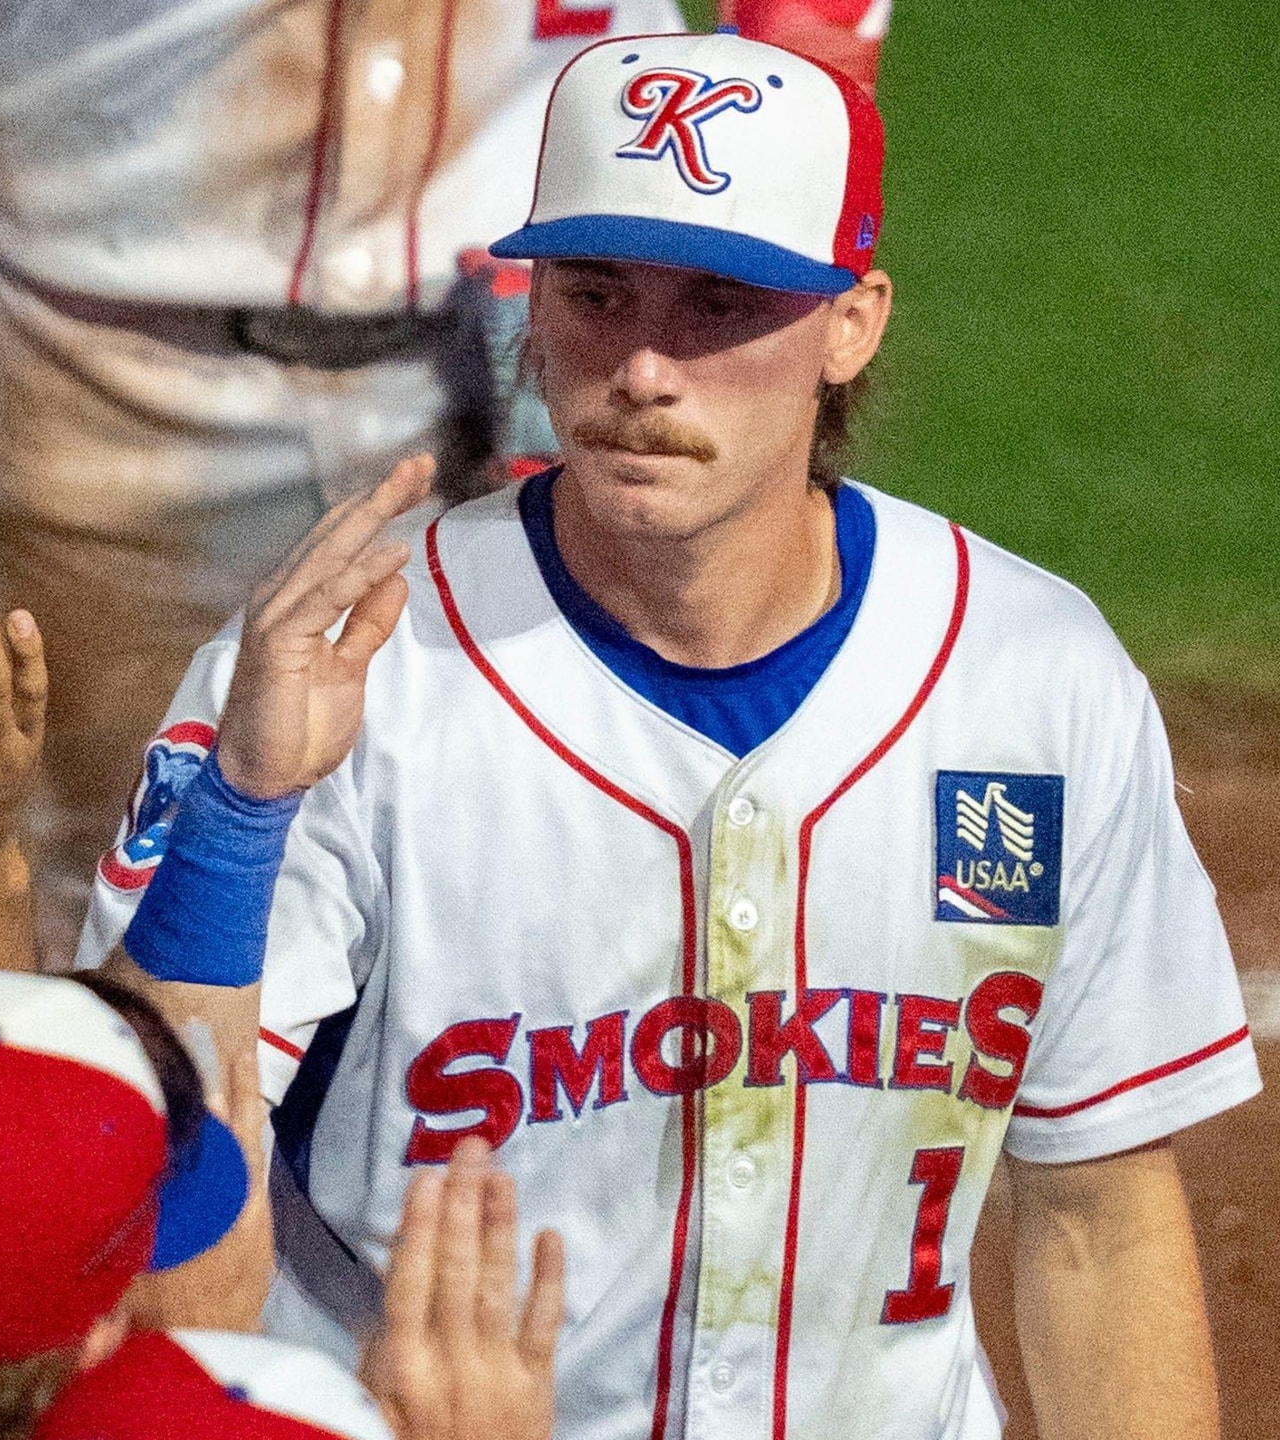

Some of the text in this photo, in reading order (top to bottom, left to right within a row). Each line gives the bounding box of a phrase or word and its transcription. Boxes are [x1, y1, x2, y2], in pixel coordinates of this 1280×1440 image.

[616, 66, 763, 196] K
[403, 971, 1045, 1167] SMOKIES
[879, 1146, 965, 1326] 1
